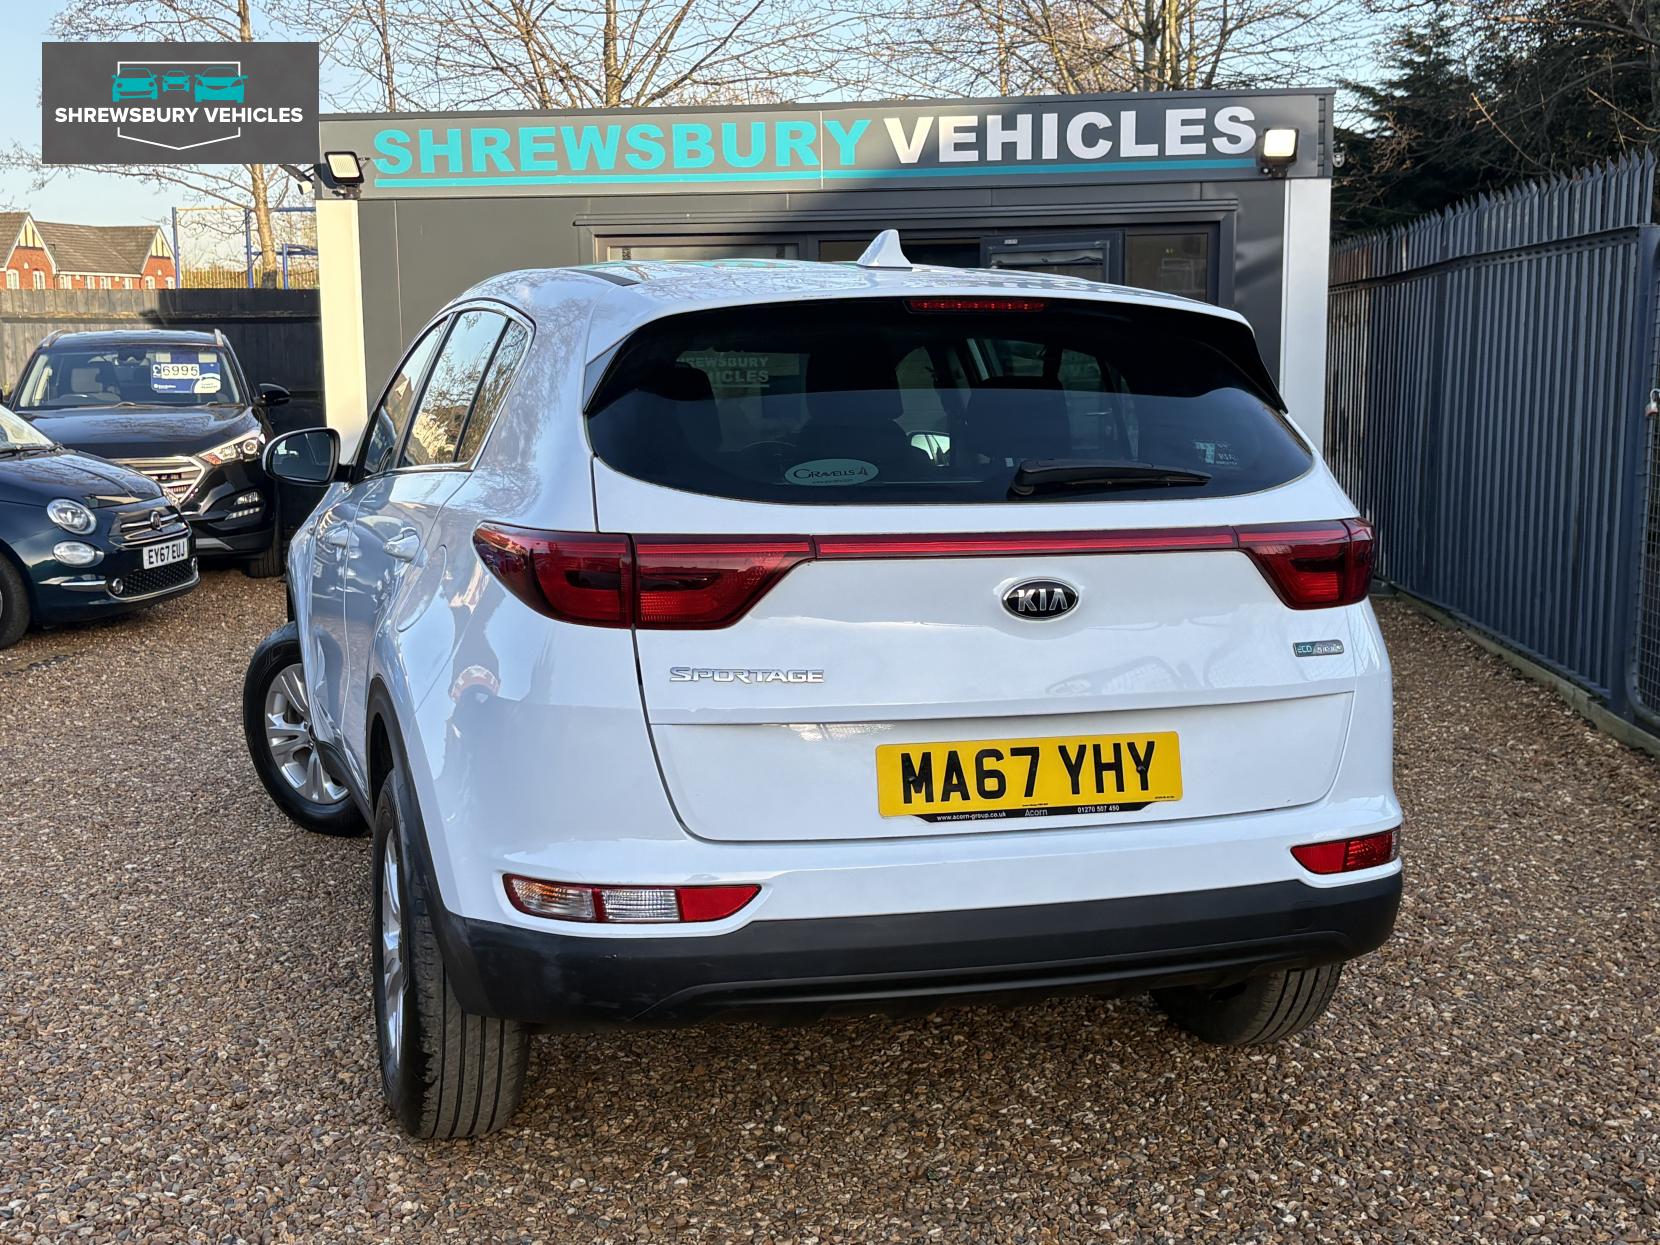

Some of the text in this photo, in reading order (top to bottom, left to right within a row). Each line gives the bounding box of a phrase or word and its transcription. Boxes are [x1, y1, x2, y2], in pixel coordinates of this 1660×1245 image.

[372, 106, 1256, 175] SHREWSBURY VEHICLES
[148, 540, 185, 565] EY67 EUJ
[1017, 587, 1068, 612] KIA
[669, 666, 825, 684] SPORTAGE
[900, 740, 1156, 805] MA67 YHY
[937, 810, 1007, 821] www.acorn-group.co.uk
[1024, 808, 1048, 817] Acorn
